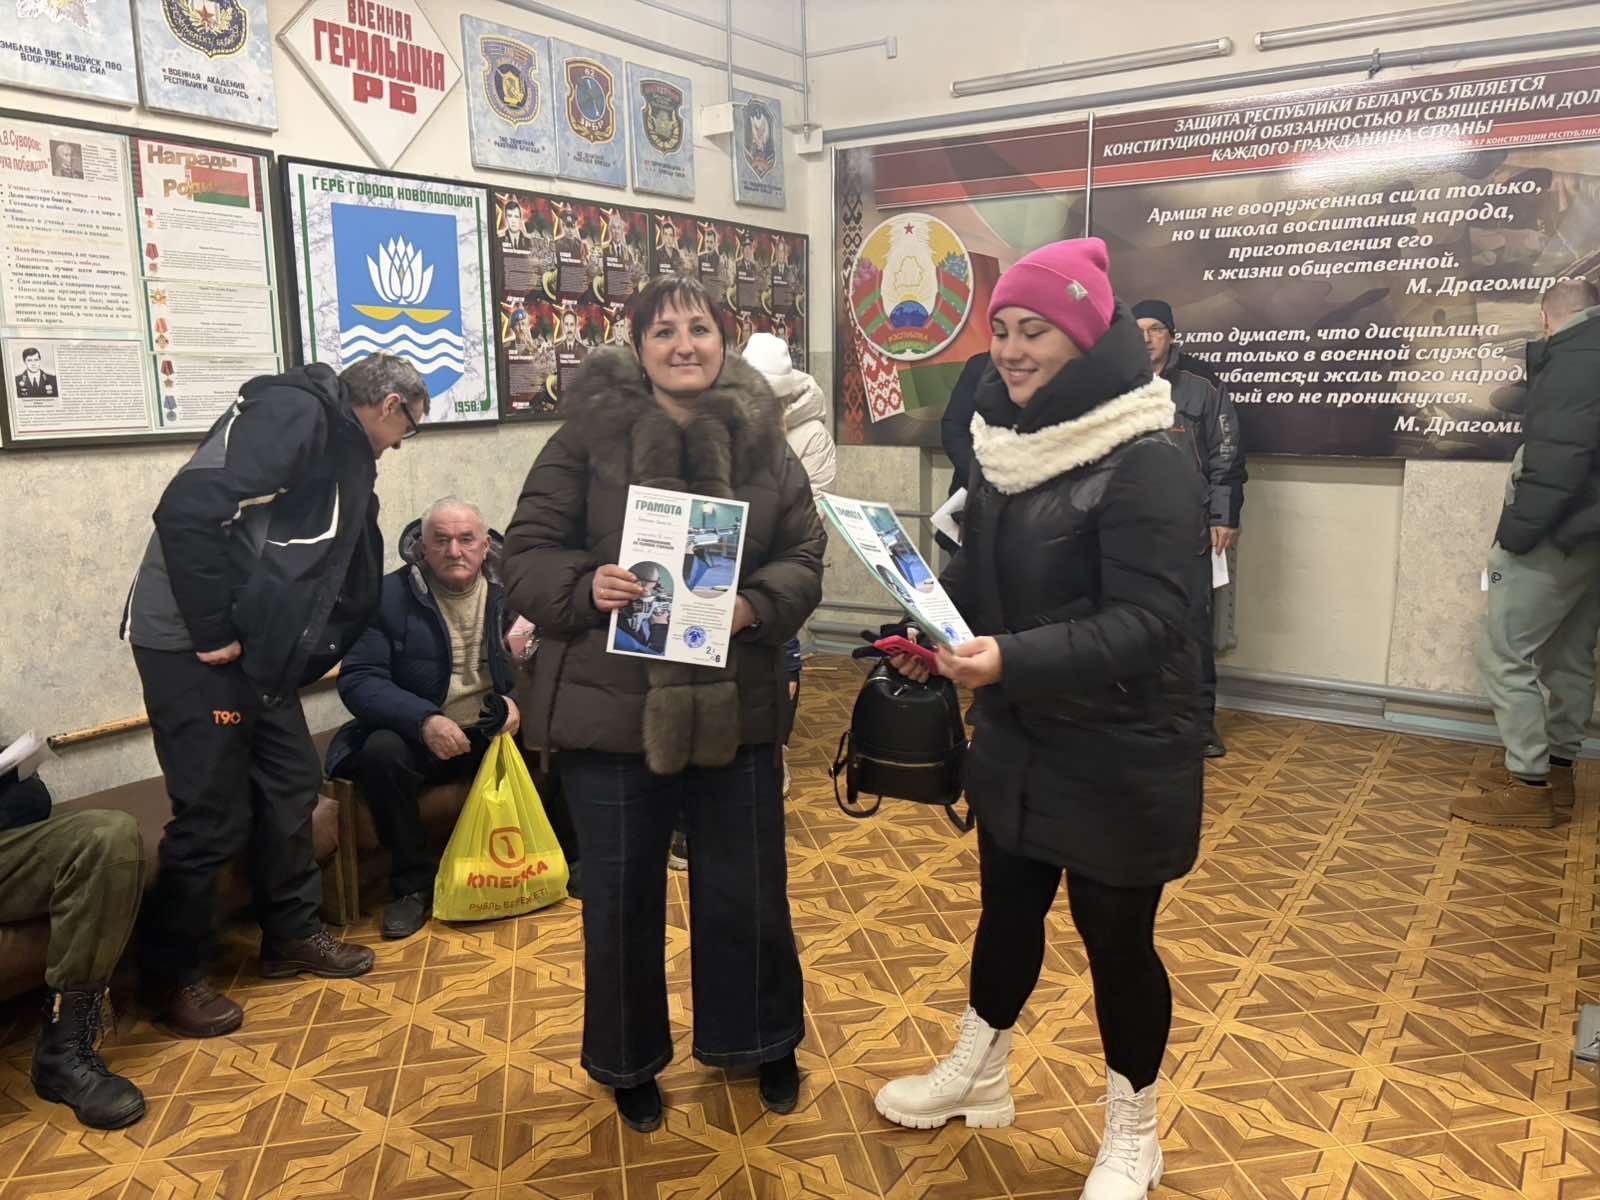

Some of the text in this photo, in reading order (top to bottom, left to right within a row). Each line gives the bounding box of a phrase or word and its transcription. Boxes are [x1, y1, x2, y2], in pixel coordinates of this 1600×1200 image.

[347, 0, 412, 41] ВОЕННАЯ
[0, 40, 42, 56] ЭМБЛЕМА
[45, 49, 62, 60] ВВС
[74, 54, 101, 66] ВОЙСК
[105, 61, 122, 71] ПВО
[313, 18, 445, 92] ГЕРАЛЬДИКА
[90, 66, 106, 76] СИЛ
[207, 76, 245, 90] АКАДЕМИЯ
[352, 72, 417, 114] РБ
[1174, 76, 1546, 133] ЗАЩИТА РЕСПУБЛИКИ БЕЛАРУСЬ ЯВЛЯЕТСЯ
[1103, 125, 1260, 157] КОНСТИТУЦИОННОЙ
[1261, 109, 1402, 139] ОБЯЗАННОСТЬЮ
[1405, 109, 1420, 123] И
[1424, 94, 1555, 119] СВЯЩЕННЫМ
[1211, 120, 1494, 162] КАЖДОГО ГРАЖДАНИНА СТРАНЫ
[147, 144, 237, 169] Награды
[312, 176, 473, 208] ГЕРБ ГОРОДА НОВОПОЛОЦКА
[1147, 180, 1542, 225] Армия не вооруженная сила только,
[1171, 203, 1514, 241] но и школа воспитания народа,
[1228, 235, 1433, 262] приготовления его
[1202, 251, 1459, 280] к жизни общественной.
[1405, 275, 1586, 297] М. Драгомир
[1228, 327, 1311, 345] думает,
[1317, 327, 1360, 340] что
[1365, 323, 1500, 341] дисциплина
[1225, 350, 1299, 363] только
[1303, 350, 1316, 362] в
[1322, 344, 1409, 362] военной
[1415, 342, 1507, 363] службе,
[1323, 370, 1383, 383] жаль
[1387, 370, 1445, 383] того
[1266, 392, 1294, 404] ею
[1298, 392, 1322, 404] не
[1326, 391, 1473, 408] проникнулся.
[1393, 416, 1420, 432] М.
[635, 500, 682, 516] ГРАМОТА
